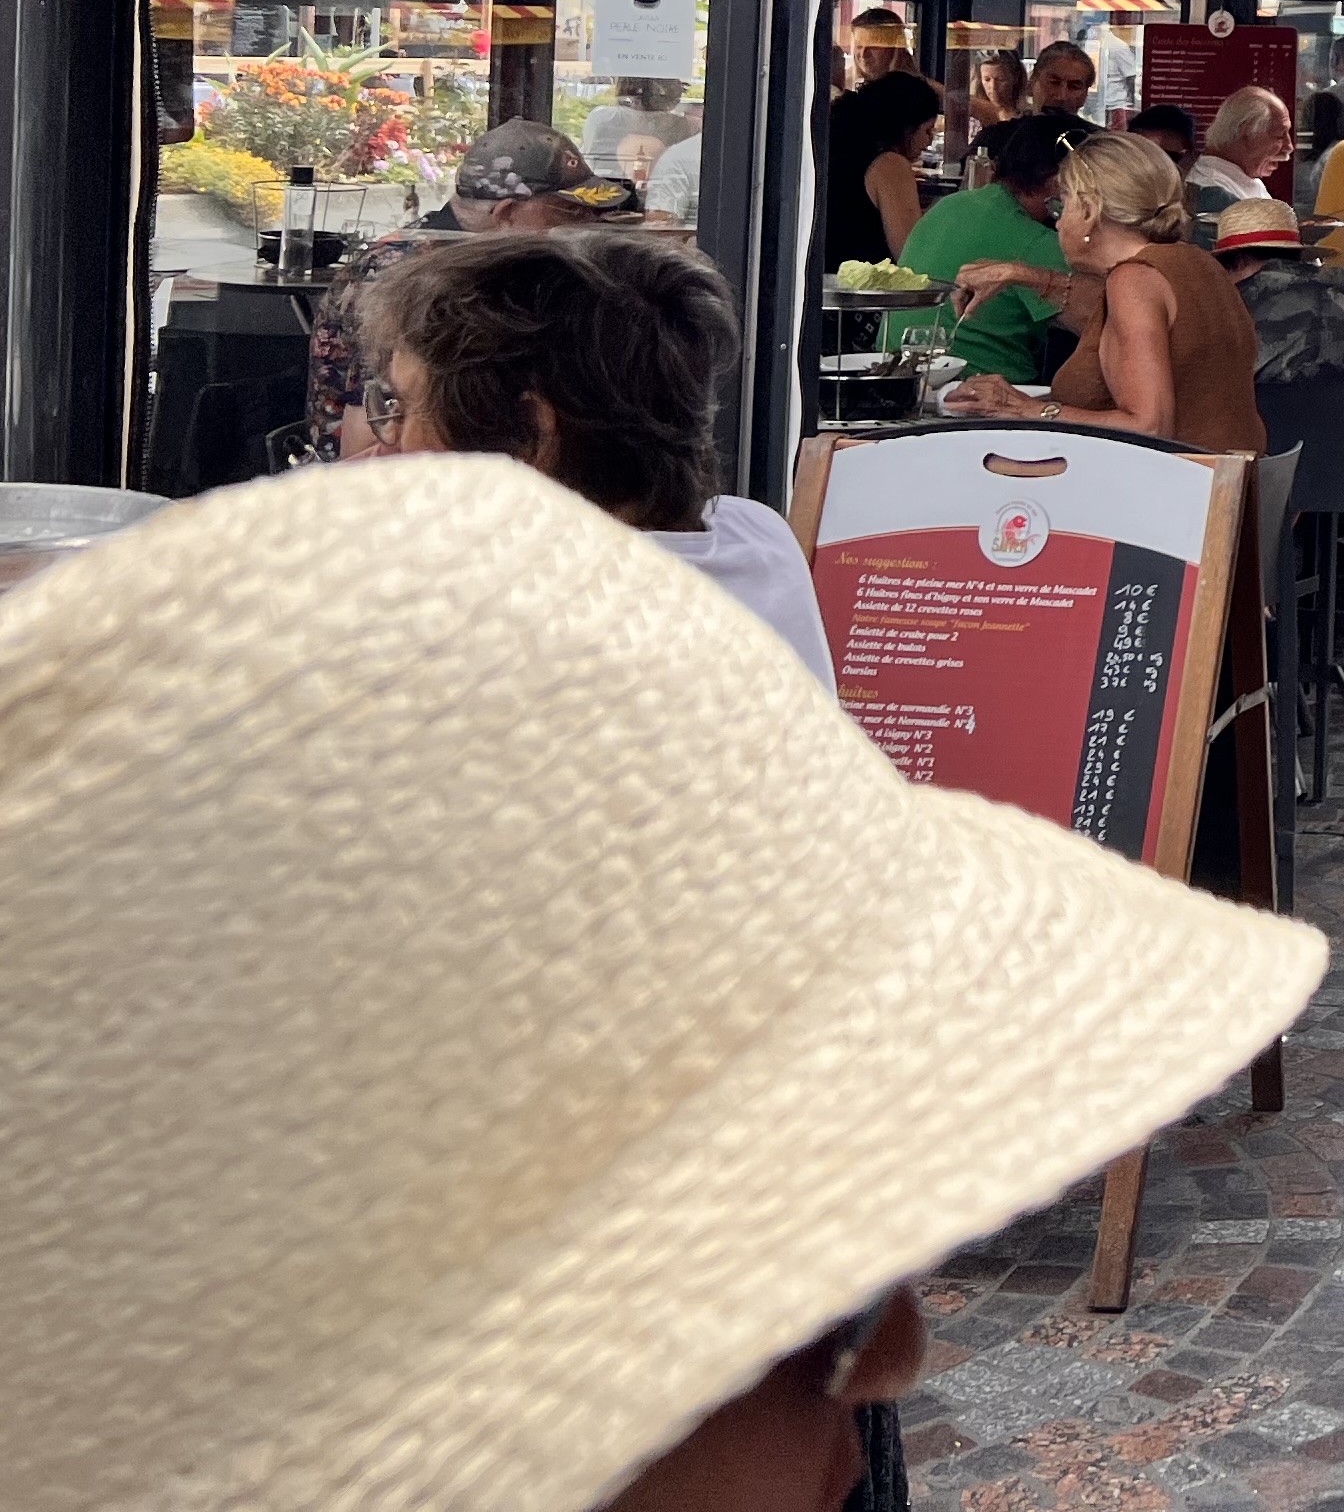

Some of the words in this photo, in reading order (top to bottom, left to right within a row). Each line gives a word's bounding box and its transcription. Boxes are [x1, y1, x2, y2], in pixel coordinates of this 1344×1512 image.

[610, 22, 638, 32] PERLE
[646, 23, 680, 33] NOIRE
[834, 551, 859, 565] Nos
[862, 556, 929, 571] suggestions
[859, 574, 867, 584] 6
[868, 574, 900, 586] Huîtres
[902, 577, 914, 586] de
[915, 578, 945, 589] pleine
[945, 581, 965, 590] mer
[986, 583, 996, 592] et
[997, 584, 1013, 592] son
[1014, 585, 1039, 594] verre
[1040, 584, 1052, 594] de
[1052, 585, 1098, 596] Muscadet
[1114, 584, 1143, 597] 10
[1146, 584, 1159, 597] €
[856, 587, 863, 597] 6
[864, 588, 898, 598] Huîtres
[900, 590, 923, 601] fines
[962, 594, 972, 603] et
[973, 595, 989, 604] son
[991, 596, 1015, 605] verre
[1016, 596, 1029, 606] de
[1030, 597, 1074, 608] Muscadet
[854, 600, 890, 611] Assiette
[891, 603, 903, 613] de
[905, 603, 917, 613] 12
[917, 606, 957, 616] crevettes
[959, 608, 983, 617] roses
[1141, 599, 1153, 611] €
[1123, 611, 1133, 625] 8
[1137, 612, 1150, 624] €
[886, 628, 899, 638] de
[900, 630, 926, 639] crabe
[927, 632, 950, 642] pour
[951, 632, 959, 642] 2
[846, 639, 882, 650] Assiette
[884, 642, 896, 651] de
[1113, 637, 1132, 650] 49
[844, 652, 880, 663] Assiette
[882, 655, 894, 664] de
[895, 656, 935, 667] crevettes
[936, 658, 964, 669] grises
[842, 665, 878, 676] Oursins
[866, 702, 885, 710] mer
[887, 702, 898, 711] de
[900, 704, 951, 715] normandie
[1092, 708, 1114, 721] 19
[863, 716, 884, 725] mer
[884, 715, 895, 725] de
[897, 716, 950, 728] Normandie
